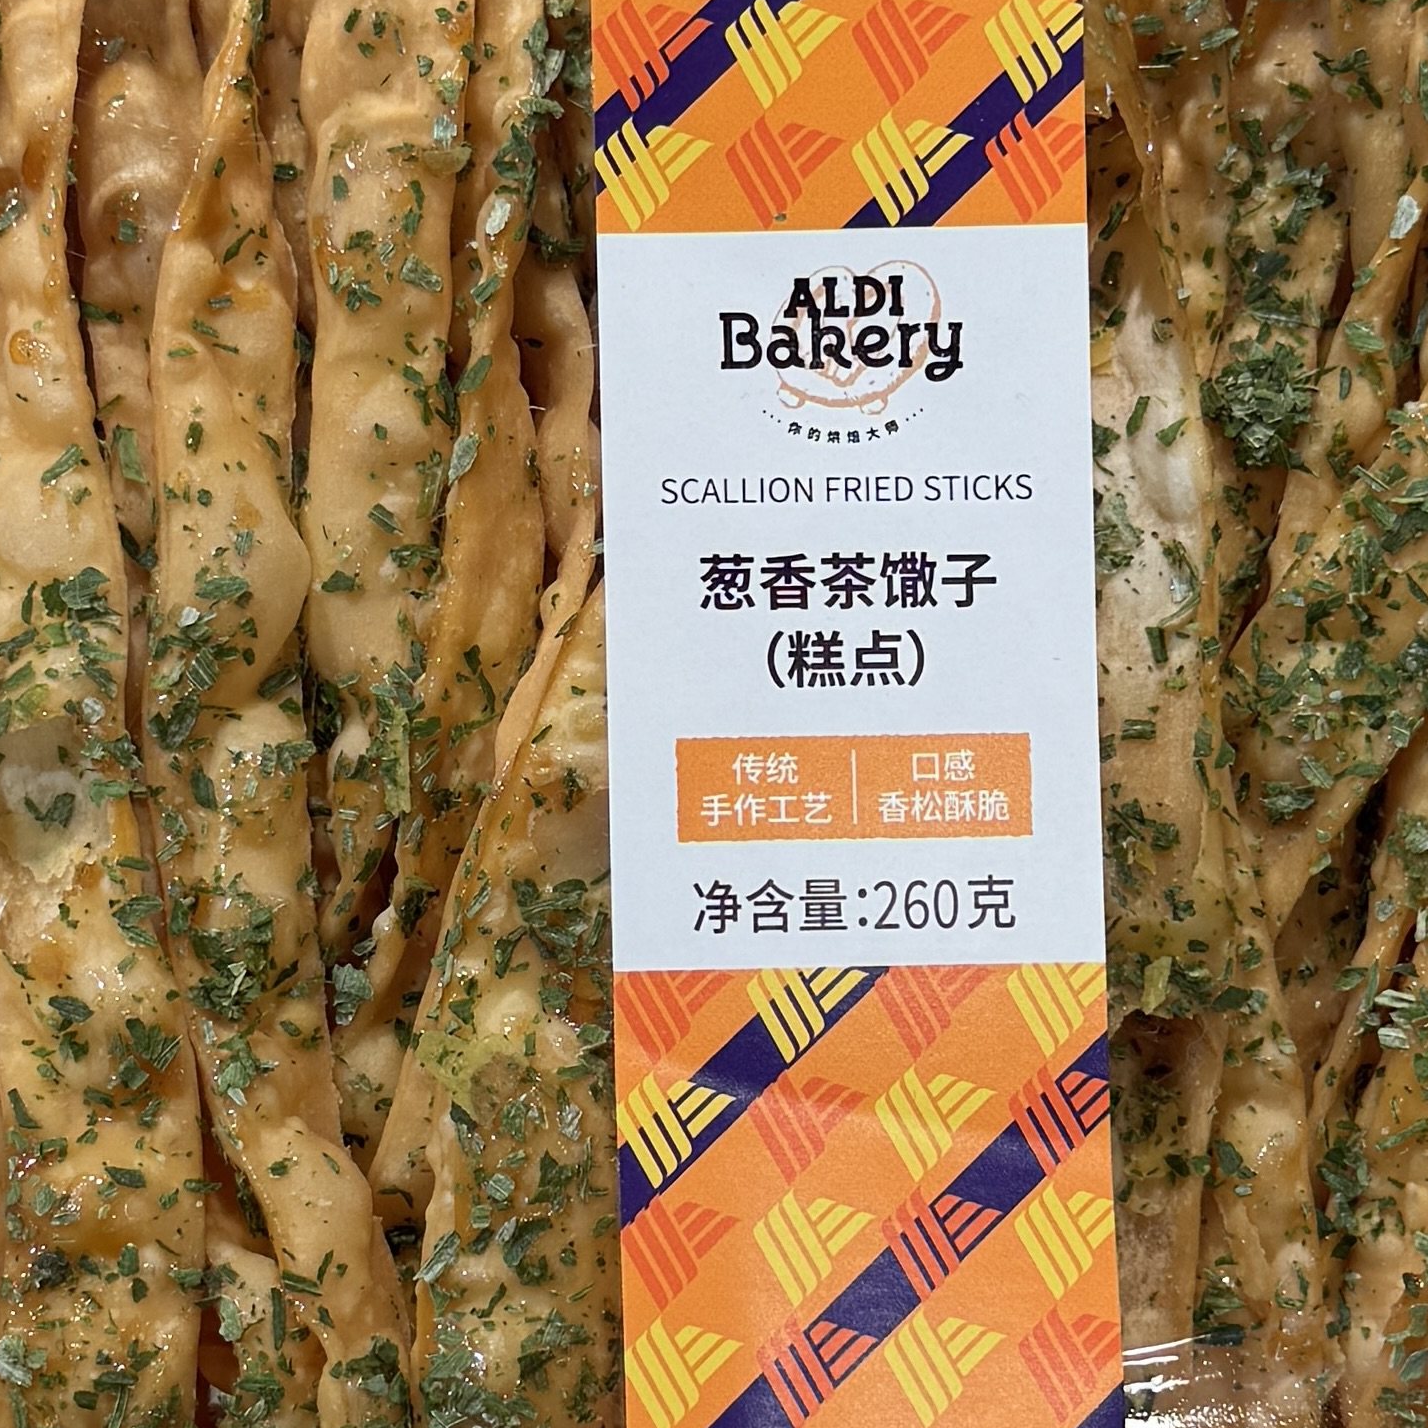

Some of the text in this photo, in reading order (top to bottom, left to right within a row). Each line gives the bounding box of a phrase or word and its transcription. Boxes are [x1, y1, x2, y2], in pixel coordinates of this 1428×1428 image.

[784, 275, 904, 317] ALDI
[720, 312, 963, 382] Bakery
[661, 474, 1033, 505] SCALLION FRIED STICKS
[700, 551, 997, 610] 葱香茶馓子
[767, 629, 925, 688] (糕点)
[732, 752, 799, 785] 传统
[912, 749, 975, 782] 口感
[700, 792, 833, 826] 手作工艺
[878, 789, 1010, 823] 香松酥脆
[692, 875, 1016, 935] 净含量:260克
